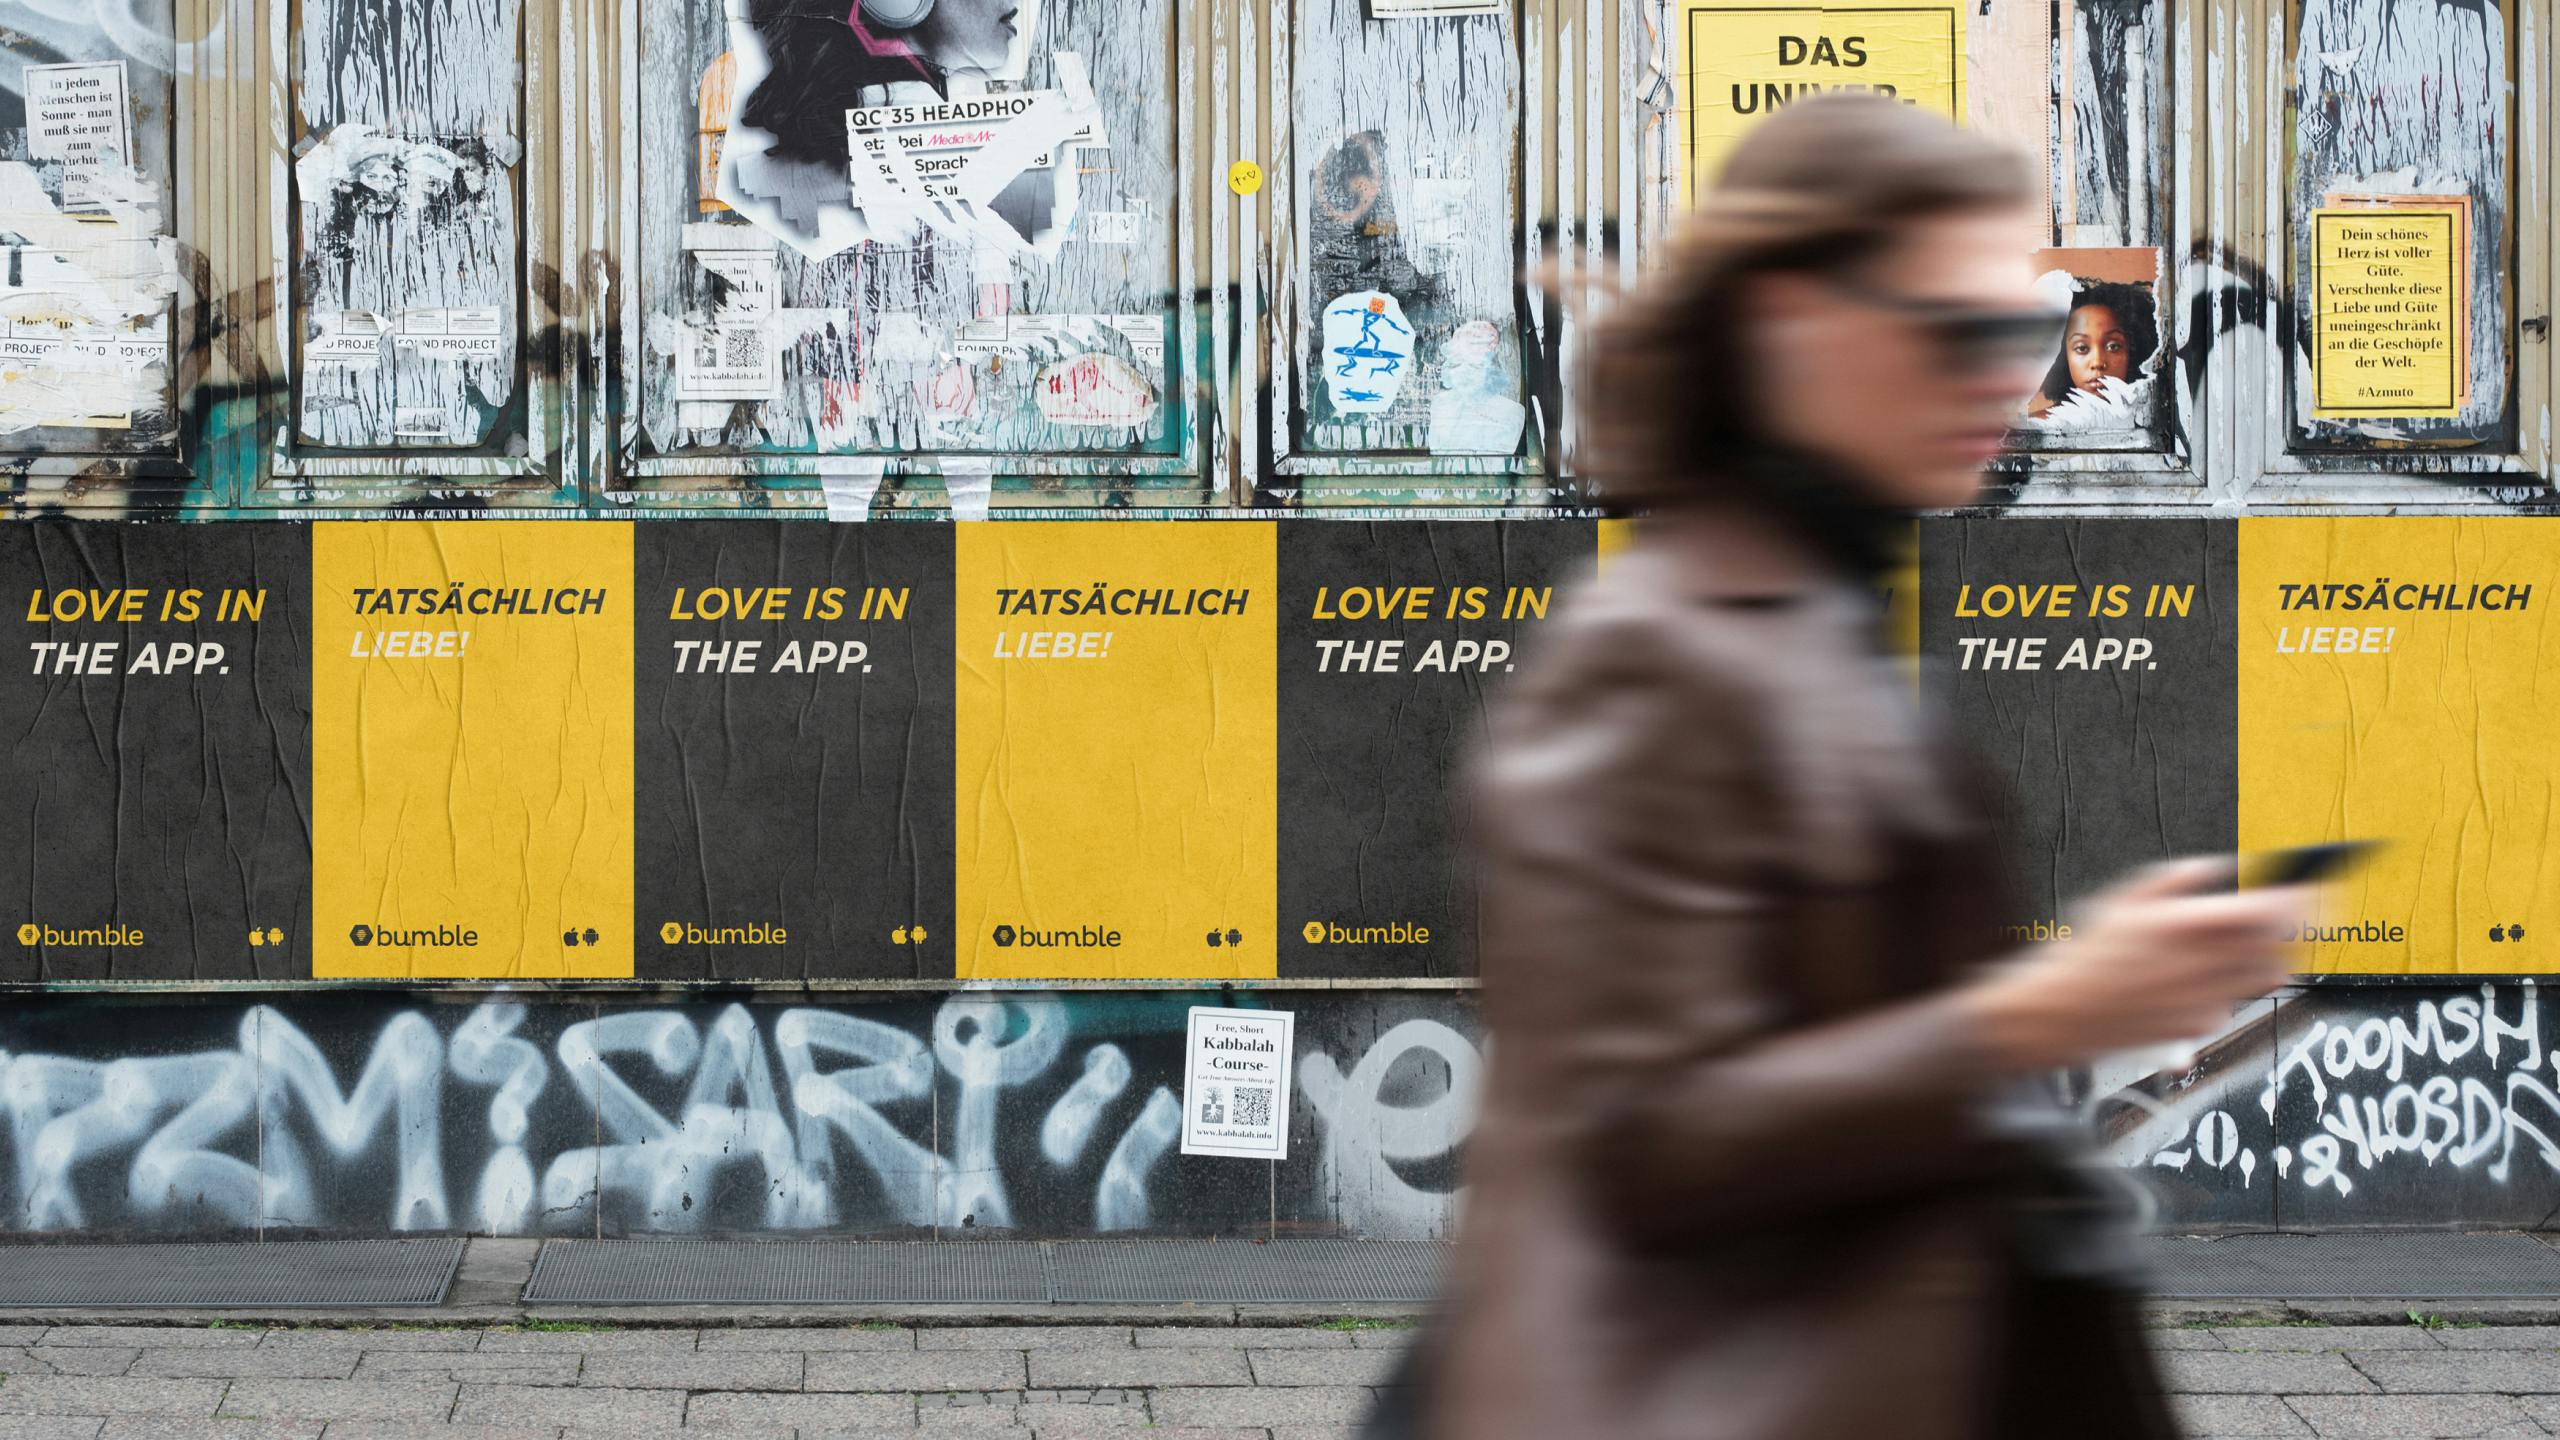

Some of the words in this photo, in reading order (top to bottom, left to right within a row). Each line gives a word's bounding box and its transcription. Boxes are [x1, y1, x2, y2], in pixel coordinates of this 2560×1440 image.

[1779, 36, 1867, 67] DAS
[65, 78, 100, 91] jedem
[40, 93, 96, 106] Menschen
[99, 91, 112, 101] ist
[41, 110, 76, 121] Sonne
[87, 109, 112, 119] man
[891, 107, 915, 123] 35
[923, 98, 1034, 121] HEADPHO
[44, 125, 70, 137] muß
[73, 123, 88, 135] sie
[91, 124, 112, 134] nur
[67, 141, 91, 151] zum
[2342, 228, 2372, 240] Dein
[2377, 228, 2428, 241] schönes
[2338, 247, 2370, 259] Herz
[2375, 247, 2389, 258] ist
[2395, 246, 2432, 258] voller
[2367, 265, 2403, 277] Güte.
[2328, 283, 2405, 295] Verschenke
[2409, 283, 2442, 295] diese
[2333, 302, 2370, 313] Liebe
[2375, 301, 2400, 313] und
[2405, 301, 2438, 313] Güte
[2329, 319, 2441, 334] uneingeschränkt
[338, 339, 380, 350] PROJE
[443, 339, 497, 350] PROJECT
[2328, 341, 2345, 350] an
[2349, 337, 2369, 350] die
[2373, 337, 2443, 352] Geschöpfe
[2355, 356, 2378, 368] der
[2382, 356, 2416, 368] Welt.
[2358, 387, 2413, 398] #Azmuto
[26, 588, 149, 622] LOVE
[160, 588, 204, 622] IS
[216, 588, 267, 622] IN
[353, 582, 606, 615] TATSÄCHLICH
[669, 587, 792, 620] LOVE
[803, 587, 847, 620] IS
[859, 587, 910, 620] IN
[996, 582, 1249, 616] TATSÄCHLICH
[1312, 586, 1435, 620] LOVE
[1445, 586, 1489, 620] IS
[1501, 586, 1552, 620] IN
[1954, 584, 2077, 617] LOVE
[2088, 584, 2132, 617] IS
[2144, 584, 2195, 617] IN
[2279, 578, 2532, 611] TATSÄCHLICH
[350, 631, 470, 658] LIEBE!
[993, 631, 1113, 658] LIEBE!
[2275, 627, 2396, 653] LIEBE!
[29, 642, 119, 675] THE
[127, 642, 229, 675] APP.
[673, 640, 762, 673] THE
[770, 640, 873, 673] APP.
[1315, 640, 1404, 673] THE
[1412, 640, 1515, 673] APP.
[1957, 637, 2047, 670] THE
[2055, 637, 2157, 670] APP.
[44, 923, 144, 946] bumble
[377, 924, 478, 947] bumble
[687, 922, 787, 944] bumble
[1020, 925, 1121, 947] bumble
[1330, 921, 1430, 944] bumble
[2303, 919, 2404, 942] bumble
[1215, 1023, 1238, 1034] Free,
[1239, 1024, 1264, 1034] Short
[1203, 1036, 1274, 1053] Kabbalah
[1206, 1057, 1269, 1072] -Course-
[1196, 1128, 1272, 1140] www.kabbalah.info
